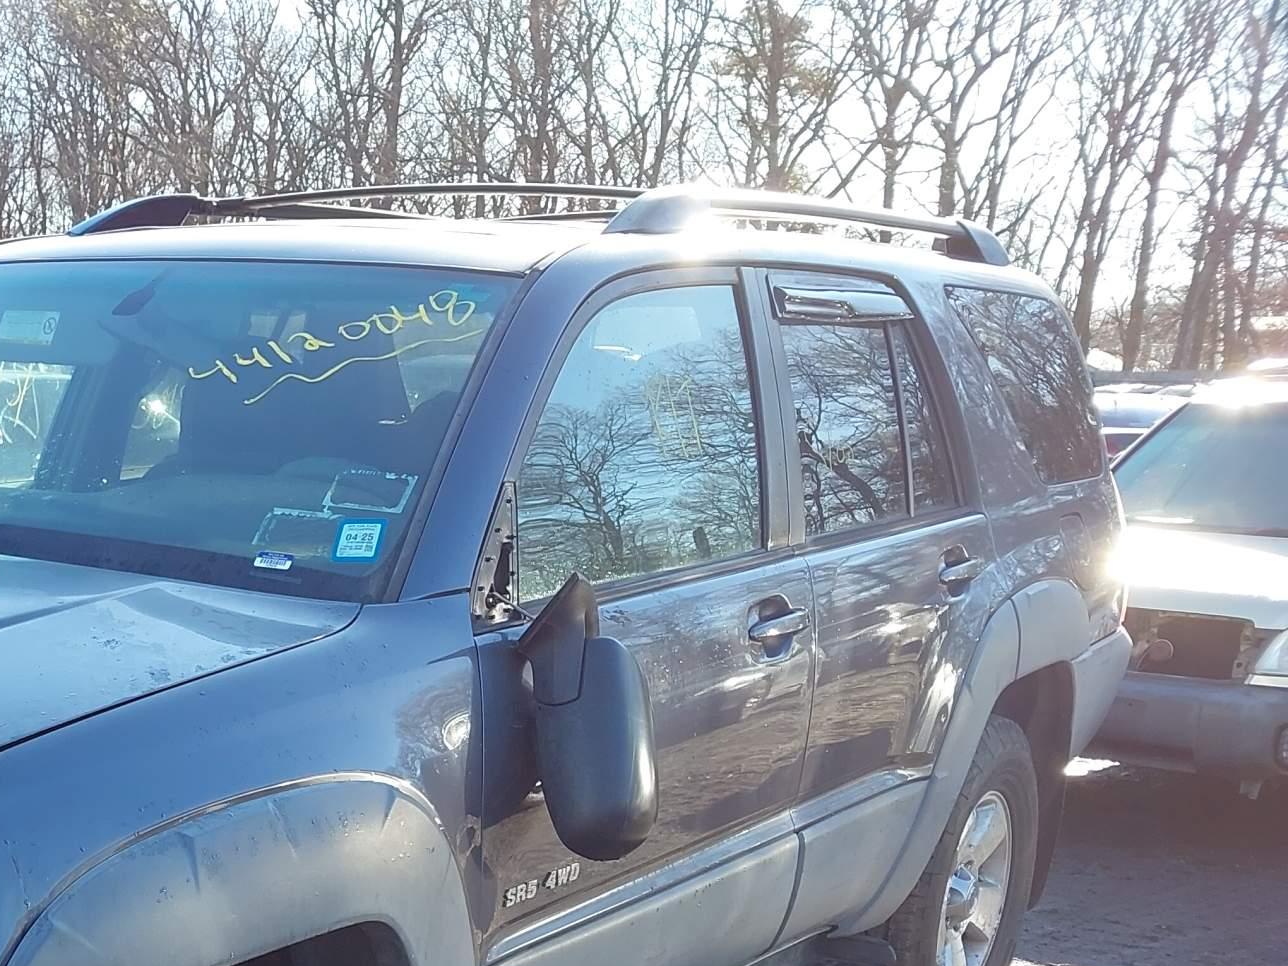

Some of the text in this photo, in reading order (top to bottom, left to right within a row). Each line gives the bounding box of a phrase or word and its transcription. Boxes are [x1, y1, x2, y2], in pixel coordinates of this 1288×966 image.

[188, 289, 476, 384] 44120048
[361, 532, 374, 541] 25
[502, 879, 539, 908] SR5
